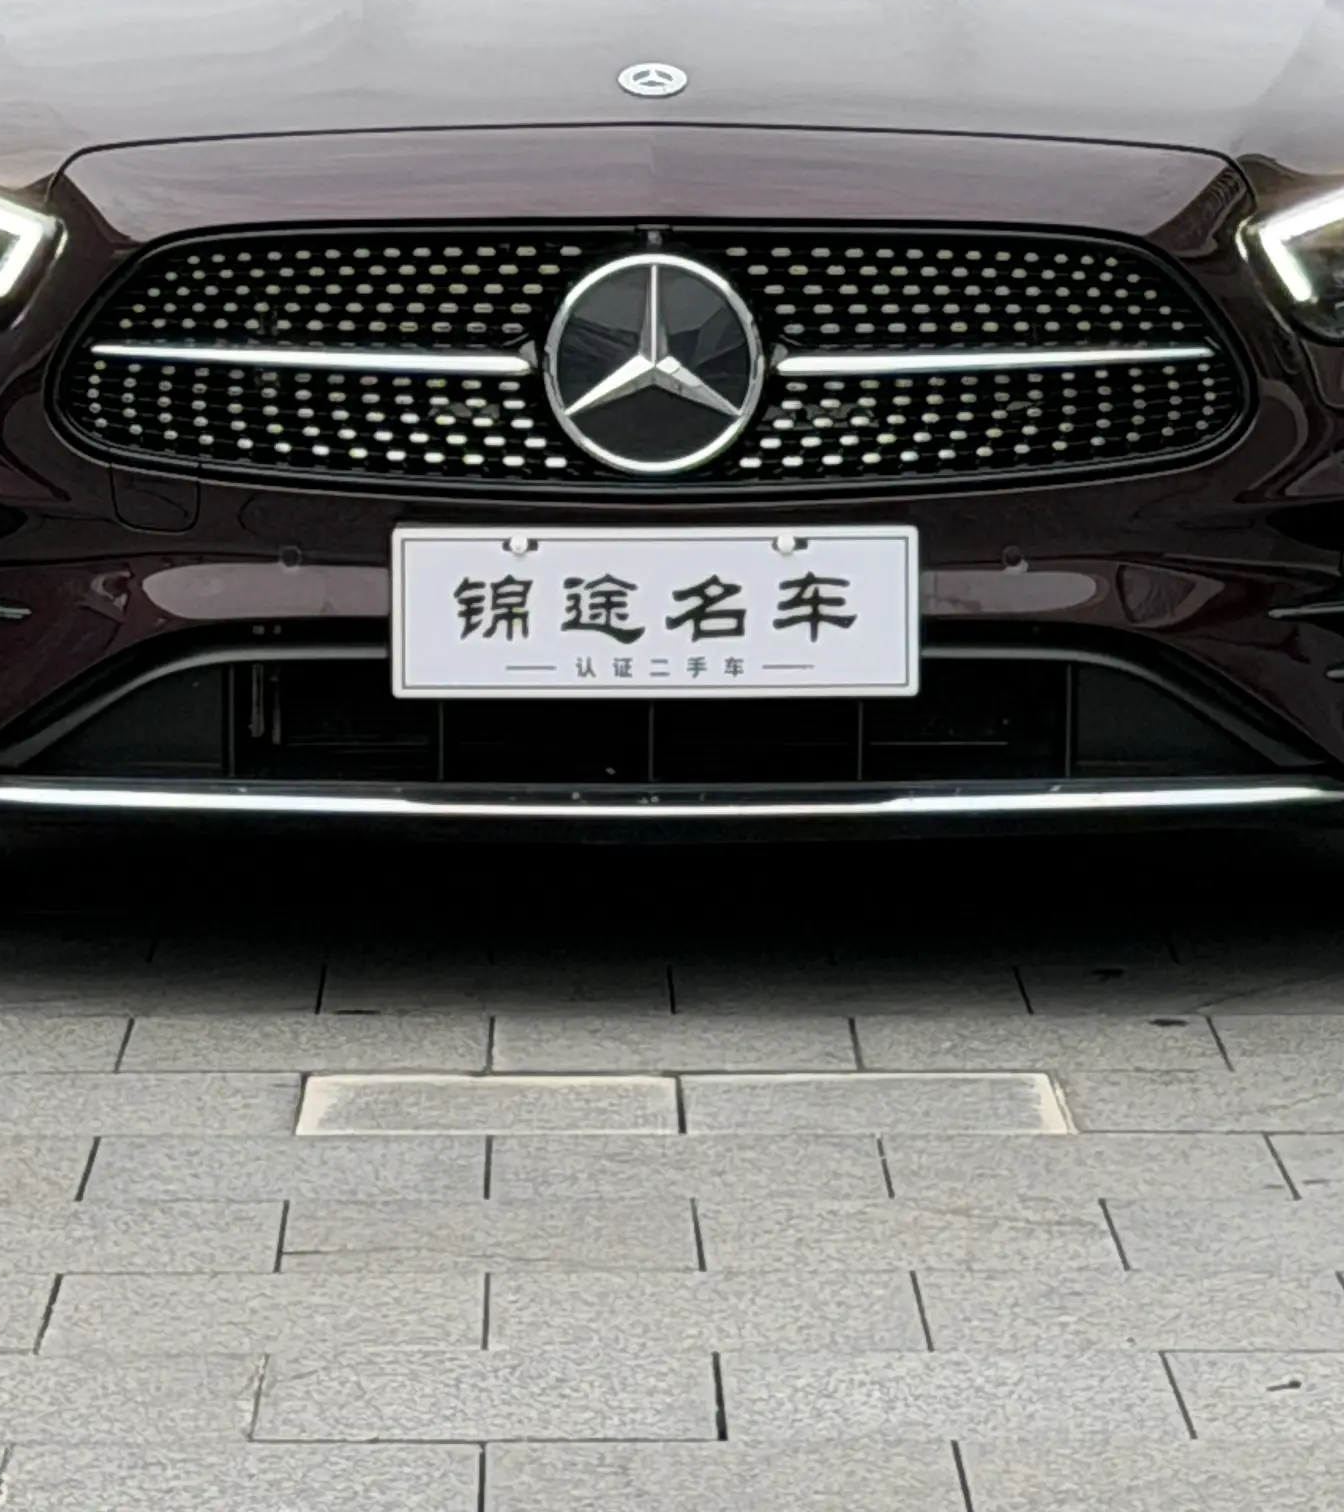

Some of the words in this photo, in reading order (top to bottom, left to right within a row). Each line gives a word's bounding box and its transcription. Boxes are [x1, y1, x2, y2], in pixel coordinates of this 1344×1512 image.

[452, 573, 859, 644] 锦途名车
[575, 656, 745, 679] 认证二手车
